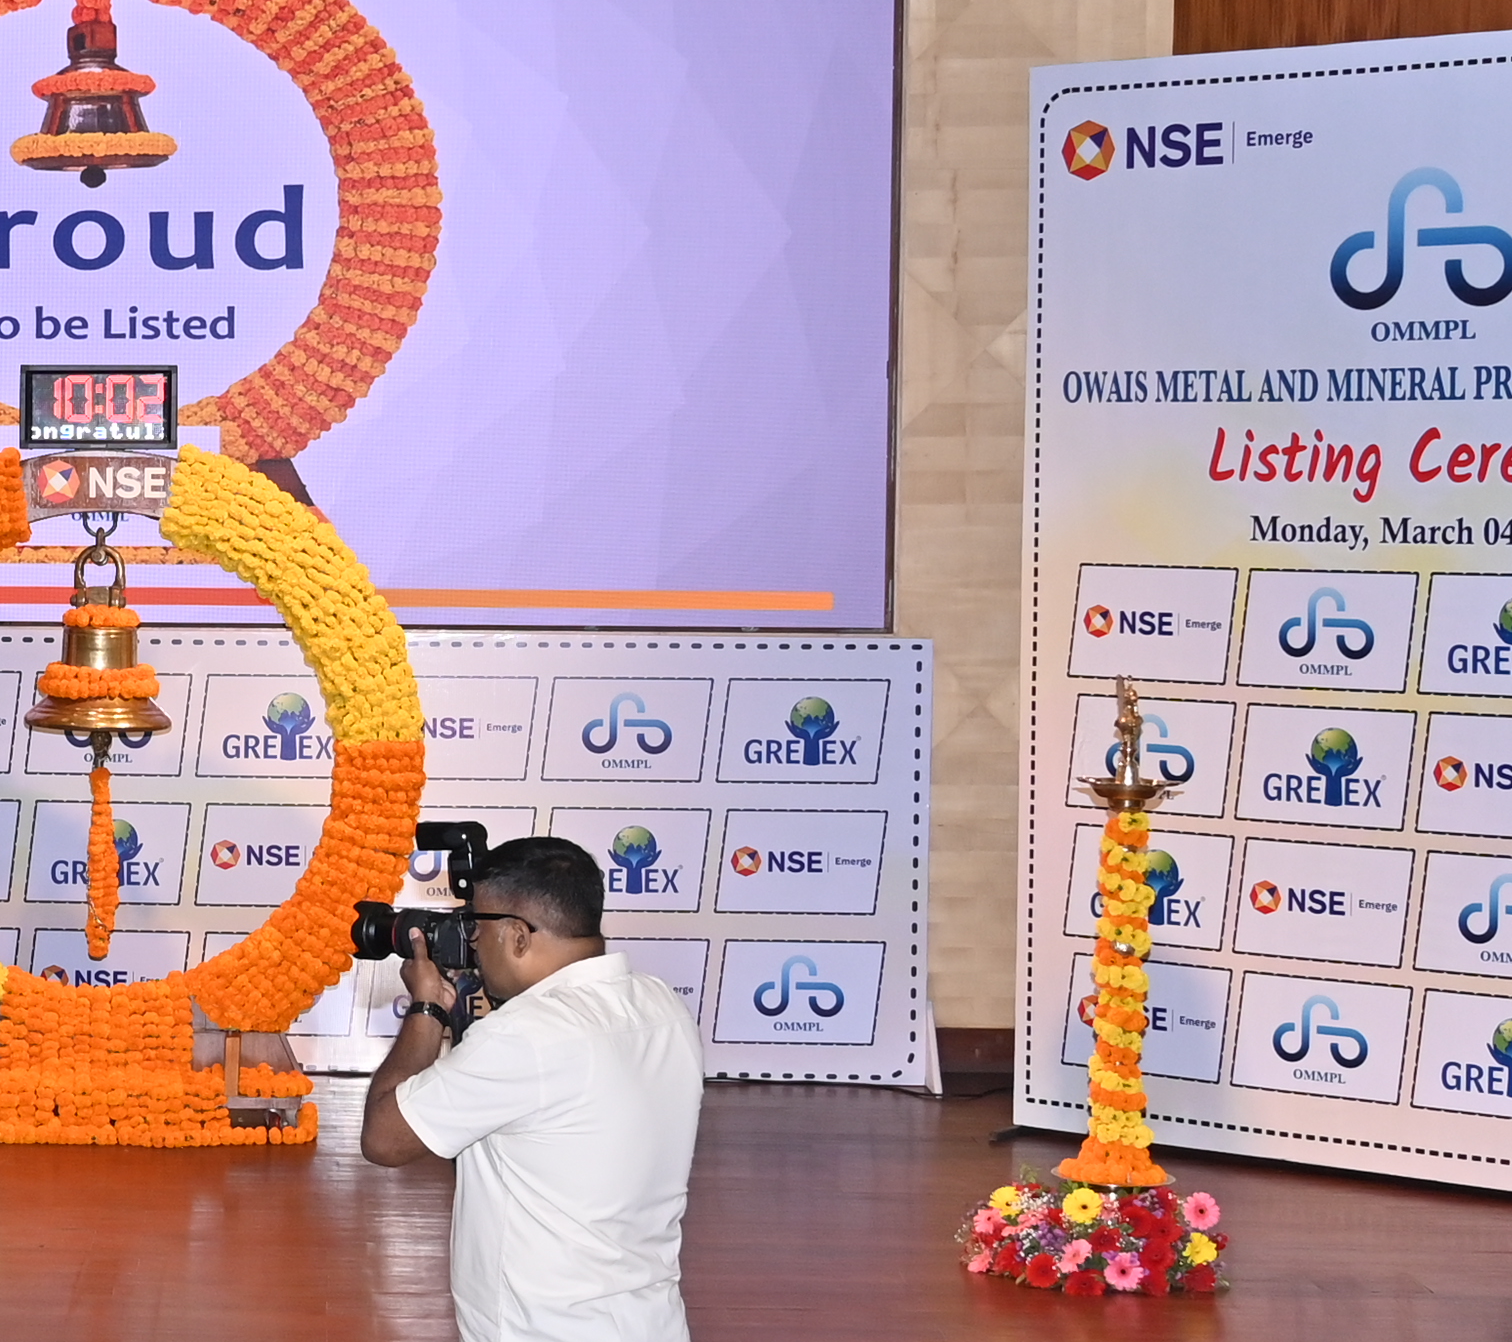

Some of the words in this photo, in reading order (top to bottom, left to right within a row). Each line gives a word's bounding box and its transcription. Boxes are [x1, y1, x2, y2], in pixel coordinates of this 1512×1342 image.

[1126, 121, 1224, 170] NSE
[1246, 129, 1314, 149] Emerge
[35, 305, 89, 340] be
[103, 305, 236, 340] Listed
[1370, 319, 1477, 343] OMMPL
[54, 375, 167, 423] 10:02
[1062, 370, 1148, 404] OWAIS
[1154, 369, 1252, 403] METAL
[1257, 368, 1319, 403] AND
[1326, 366, 1466, 402] MINERAL
[1208, 426, 1382, 504] Listing
[89, 467, 166, 498] NSE
[1249, 515, 1369, 551] Monday,
[1379, 517, 1475, 545] March
[1119, 610, 1174, 637] NSE
[601, 758, 652, 769] OMMPL
[767, 850, 823, 873] NSE
[834, 856, 872, 868] Emerge
[1292, 1068, 1347, 1085] OMMPL
